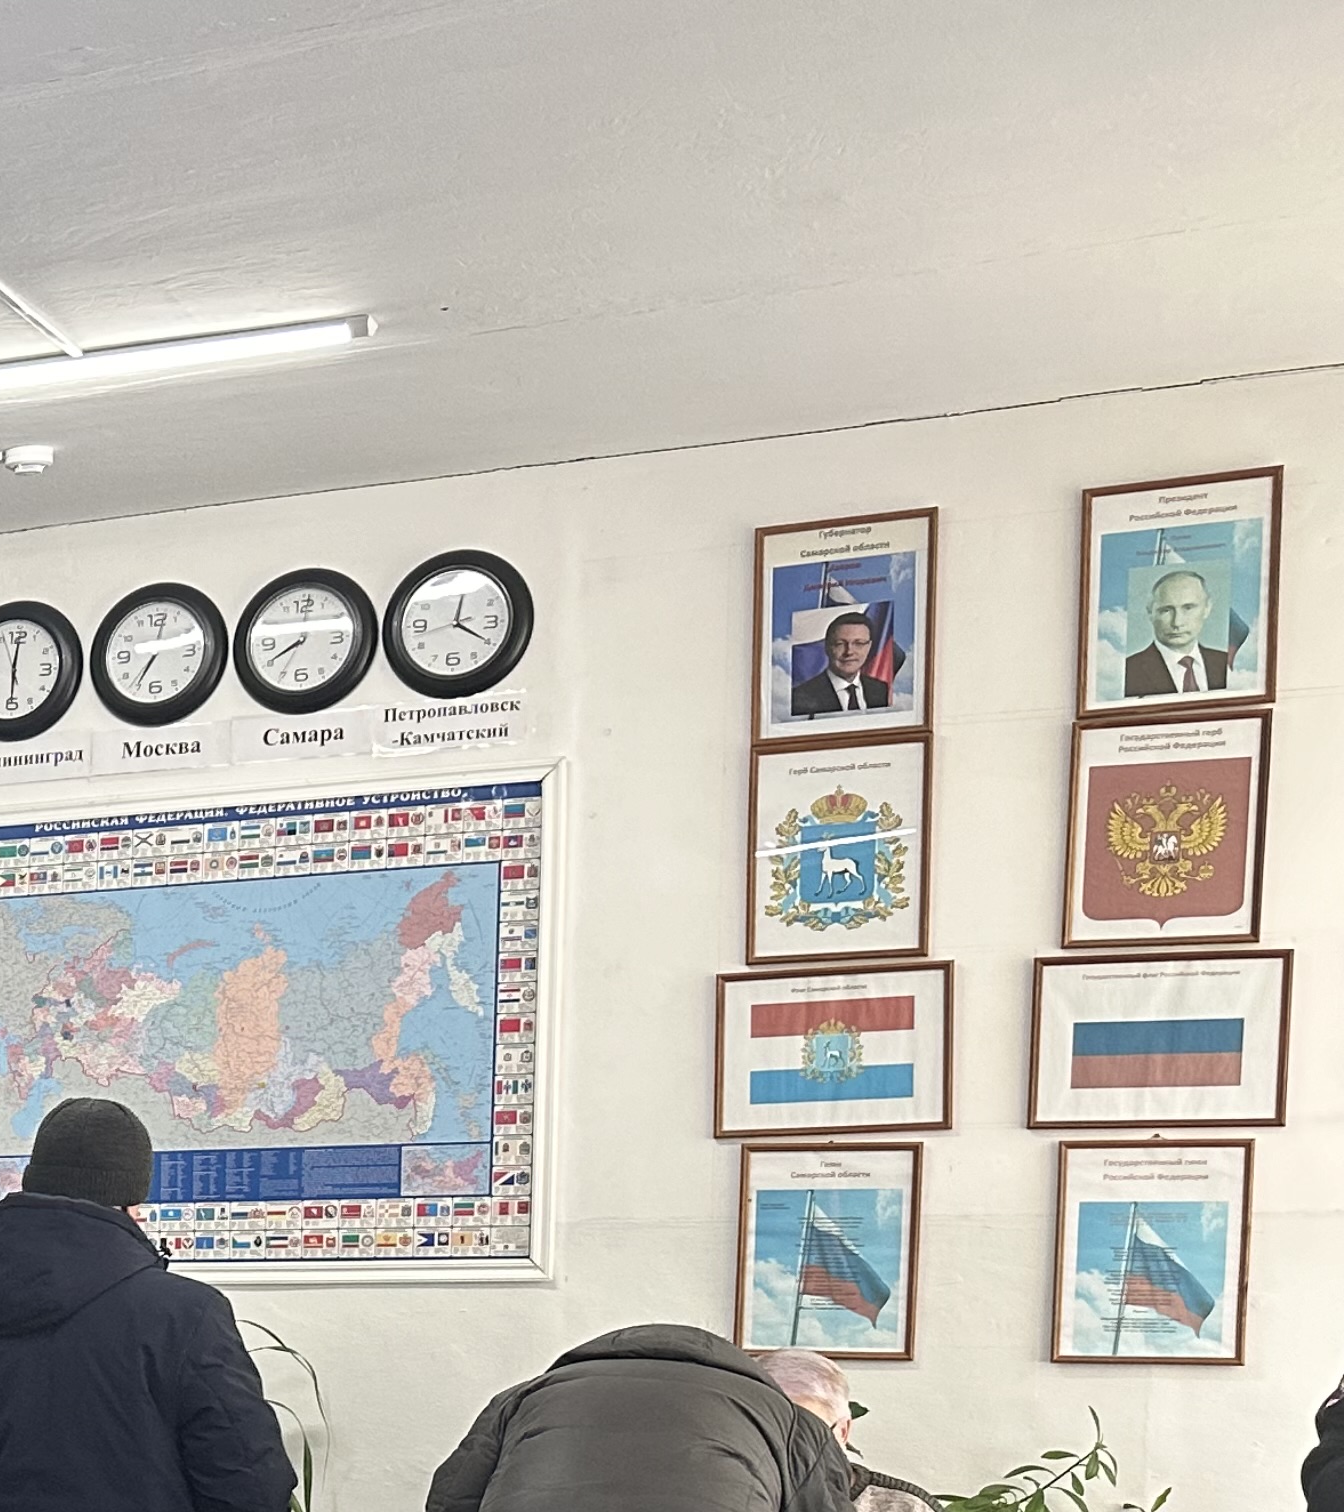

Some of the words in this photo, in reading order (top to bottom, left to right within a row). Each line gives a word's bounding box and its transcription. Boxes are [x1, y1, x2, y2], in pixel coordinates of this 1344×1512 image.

[818, 526, 872, 540] Губернатор
[799, 544, 851, 558] Самарской
[852, 541, 890, 553] области
[292, 599, 315, 614] 12
[147, 612, 168, 628] 12
[411, 618, 428, 634] 9
[482, 614, 499, 630] 3
[8, 631, 28, 645] 12
[261, 636, 277, 652] 9
[328, 630, 344, 645] 3
[116, 650, 132, 664] 9
[182, 643, 197, 658] 3
[445, 652, 461, 667] 6
[39, 662, 53, 677] 3
[294, 667, 309, 682] 6
[148, 680, 163, 695] 6
[5, 697, 19, 711] 6
[383, 700, 521, 723] Петропавловск
[262, 727, 345, 747] Самара
[391, 724, 510, 747] -Камчатский
[120, 740, 202, 760] Москва
